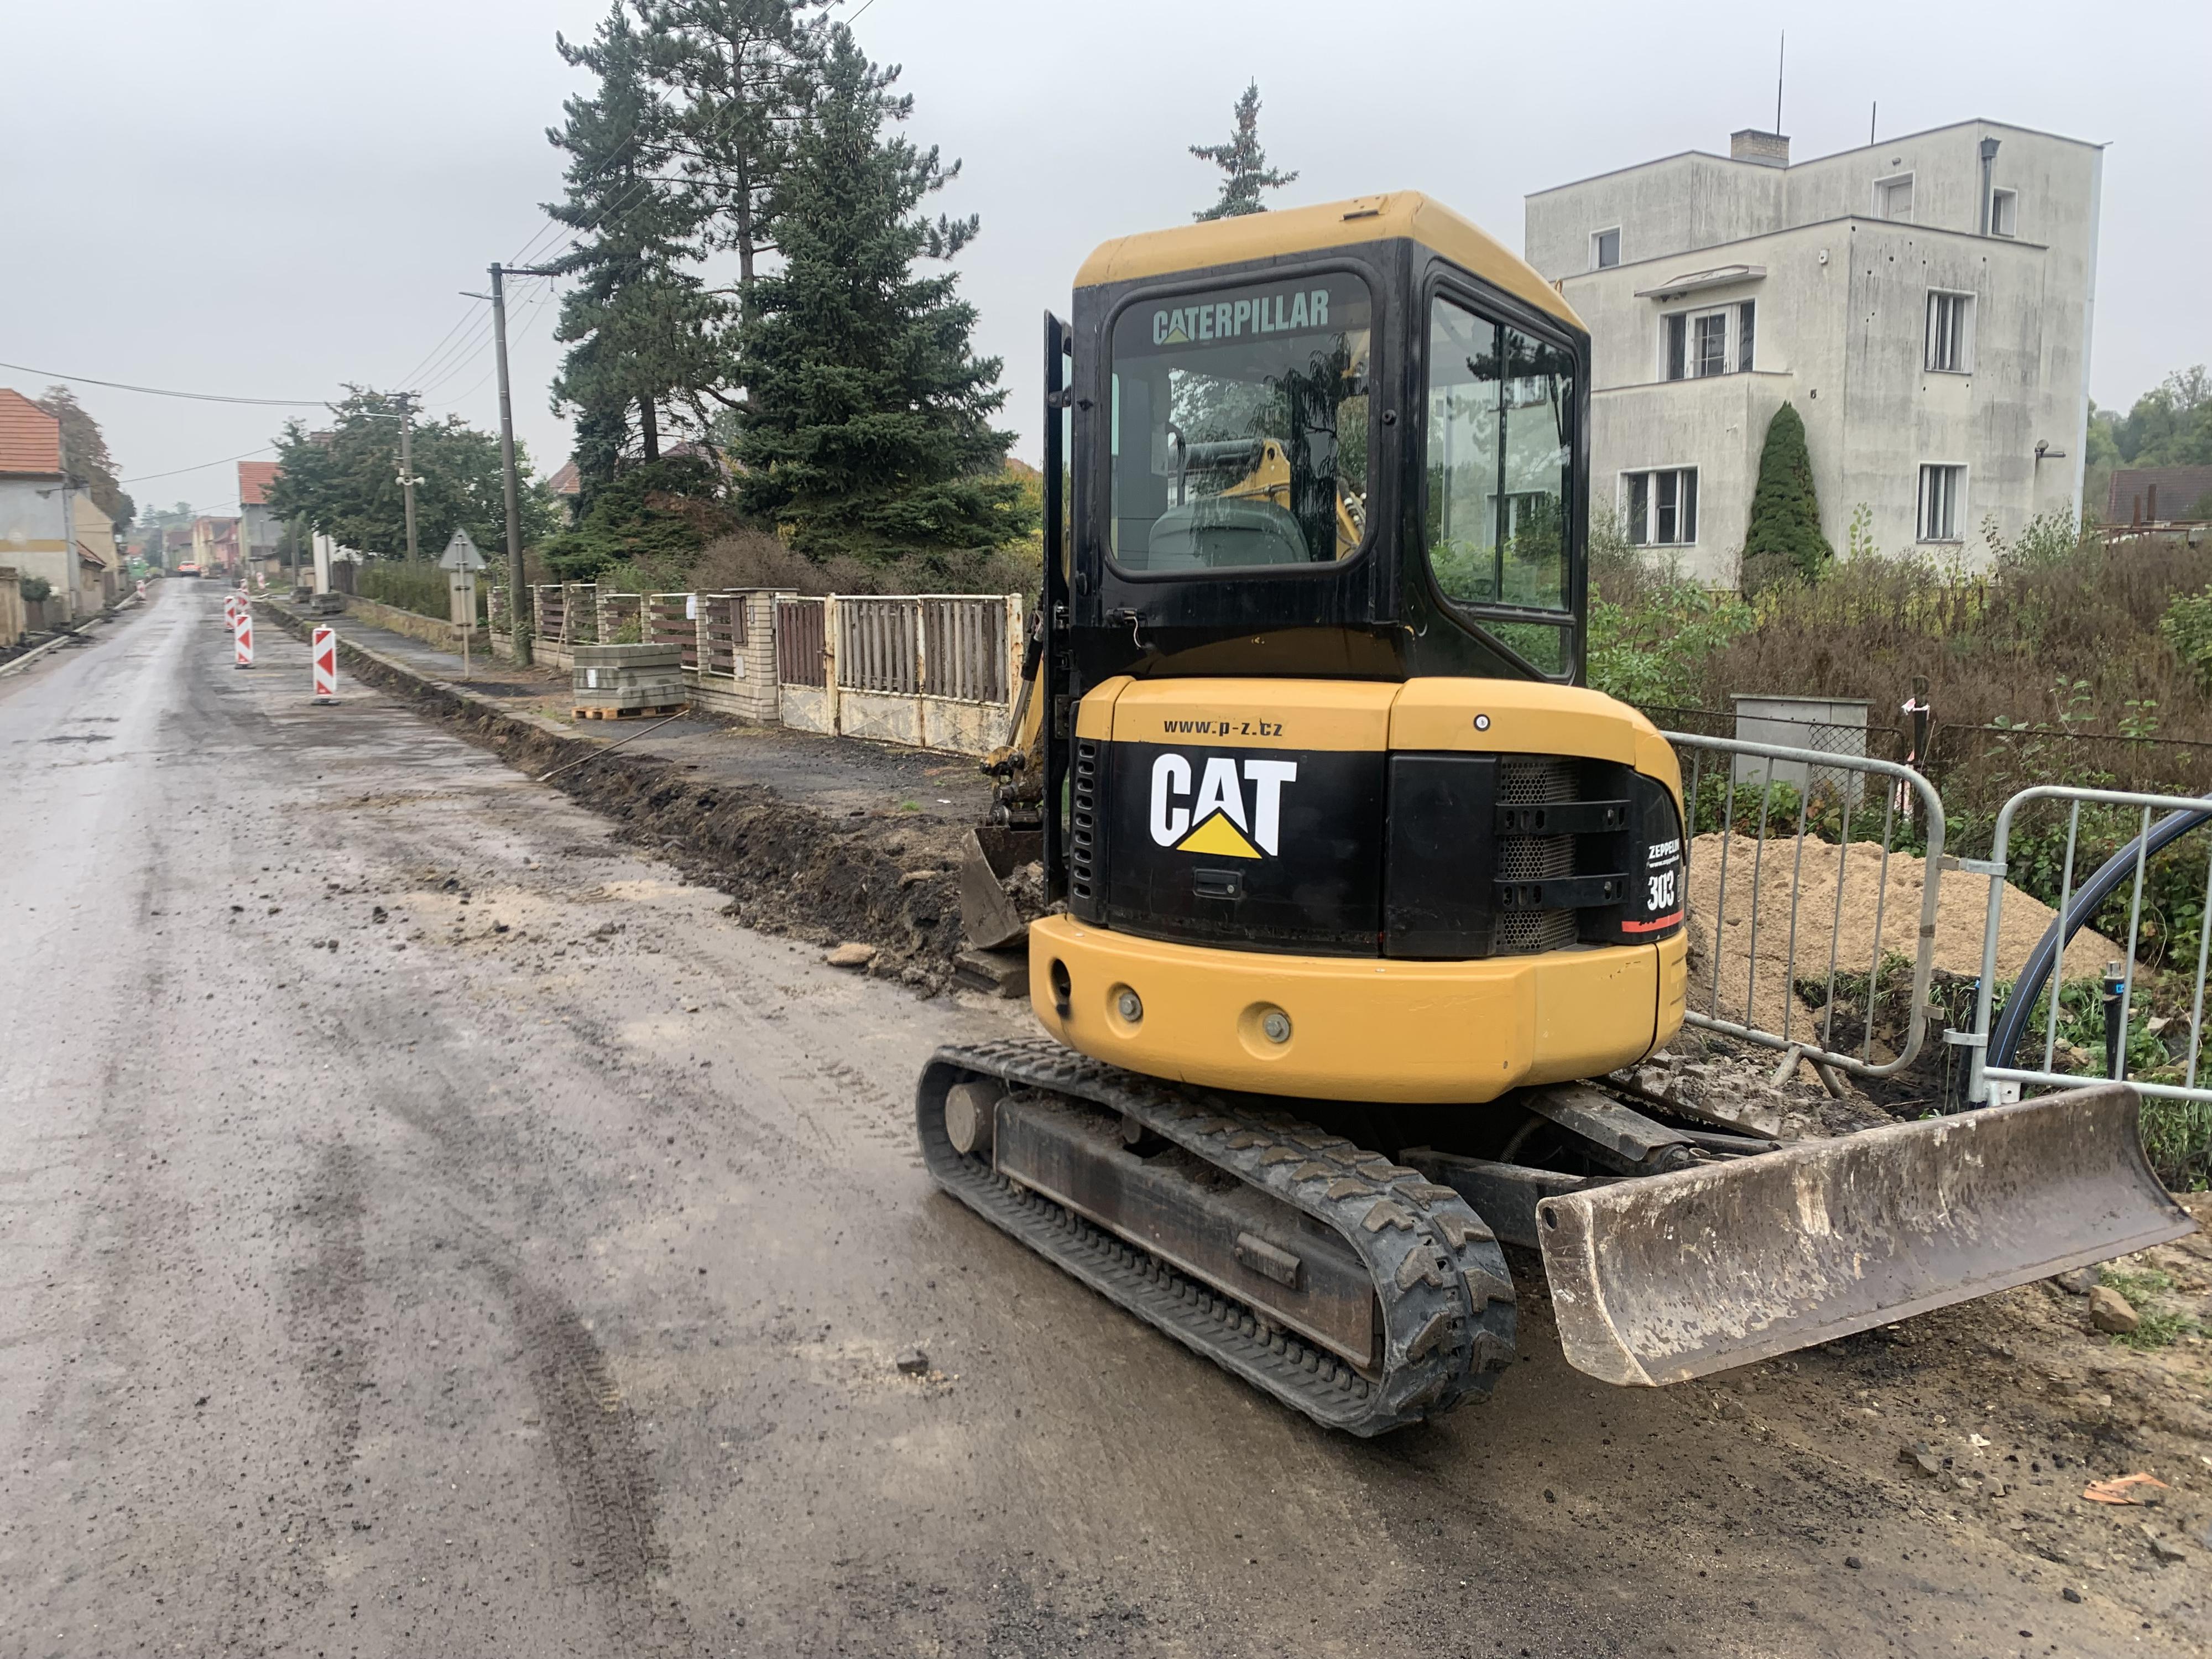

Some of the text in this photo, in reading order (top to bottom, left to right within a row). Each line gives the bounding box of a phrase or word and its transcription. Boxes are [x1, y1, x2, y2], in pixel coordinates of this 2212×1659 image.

[1153, 289, 1329, 346] CATERPILLAR
[1164, 720, 1283, 737] www.p-z.cz
[1150, 753, 1297, 857] CAT
[1648, 838, 1679, 859] ZEPPELIN
[1647, 869, 1674, 911] 303
